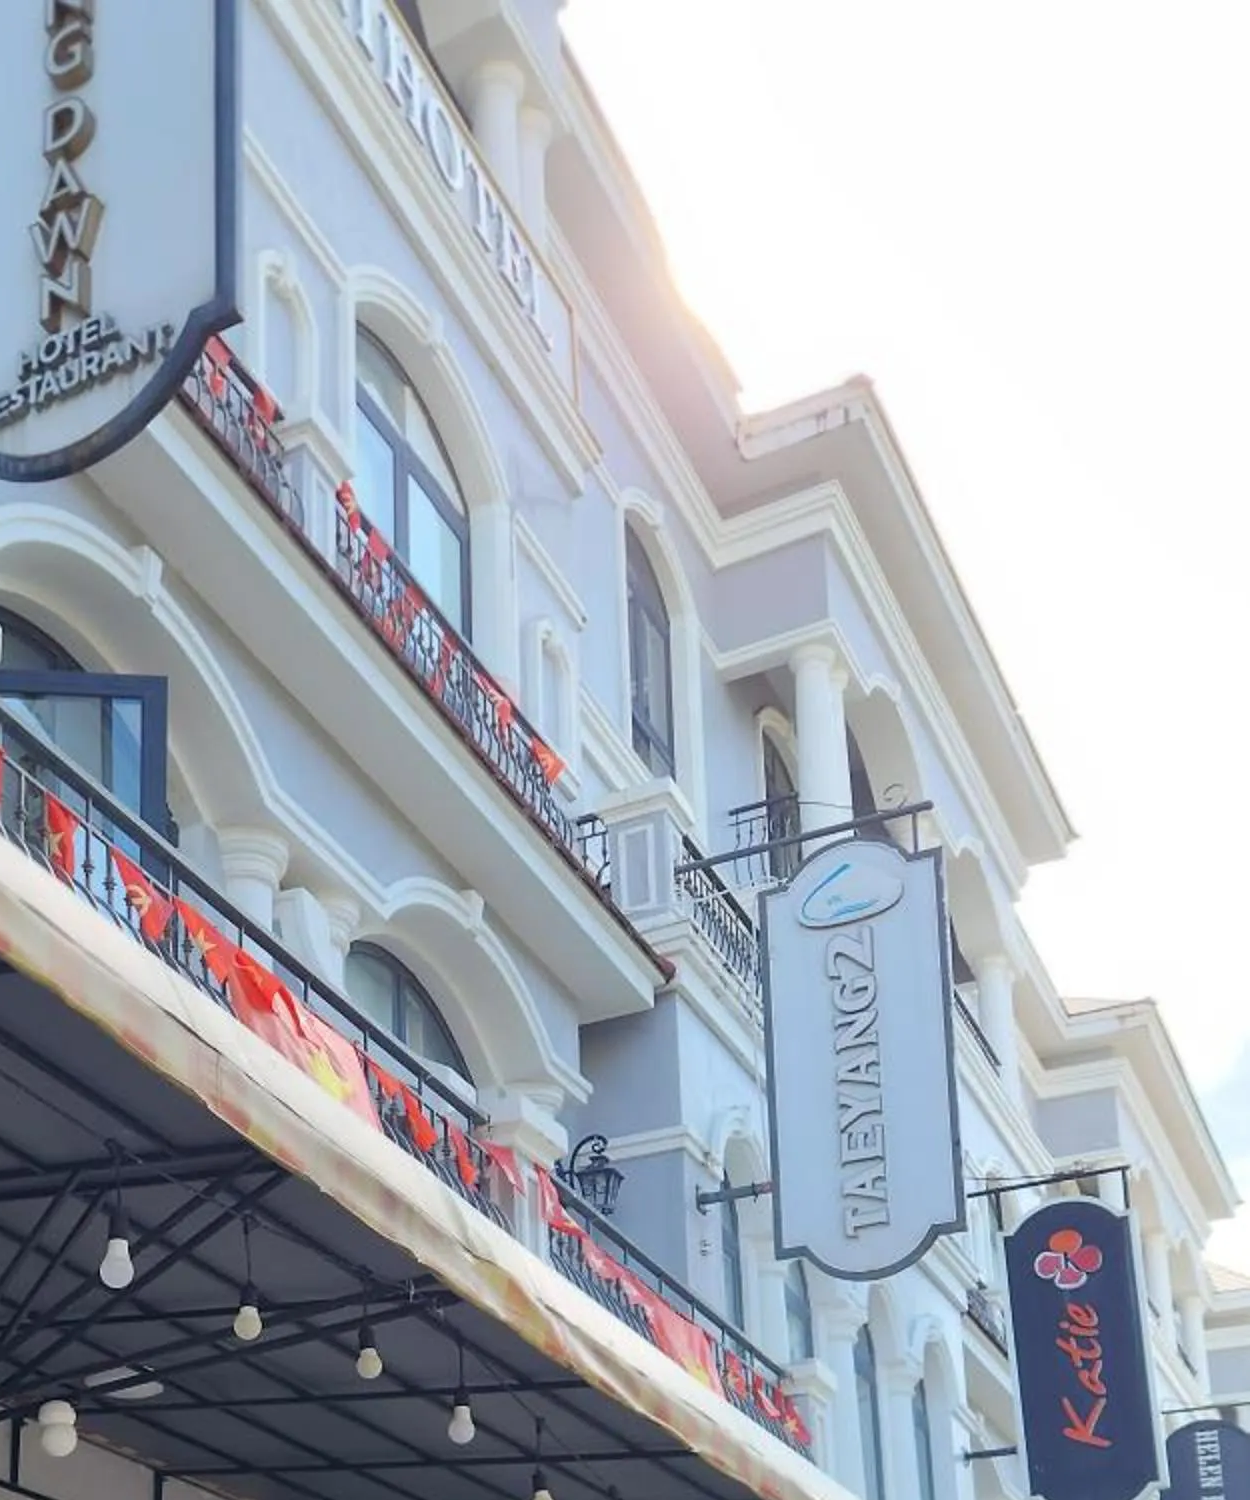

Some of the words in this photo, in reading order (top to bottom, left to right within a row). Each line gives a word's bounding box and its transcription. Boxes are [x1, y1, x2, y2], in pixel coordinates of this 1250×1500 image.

[29, 97, 104, 332] DAWN
[18, 312, 124, 384] HOTEL
[1056, 1302, 1113, 1449] Katie
[1195, 1429, 1224, 1489] HELEN
